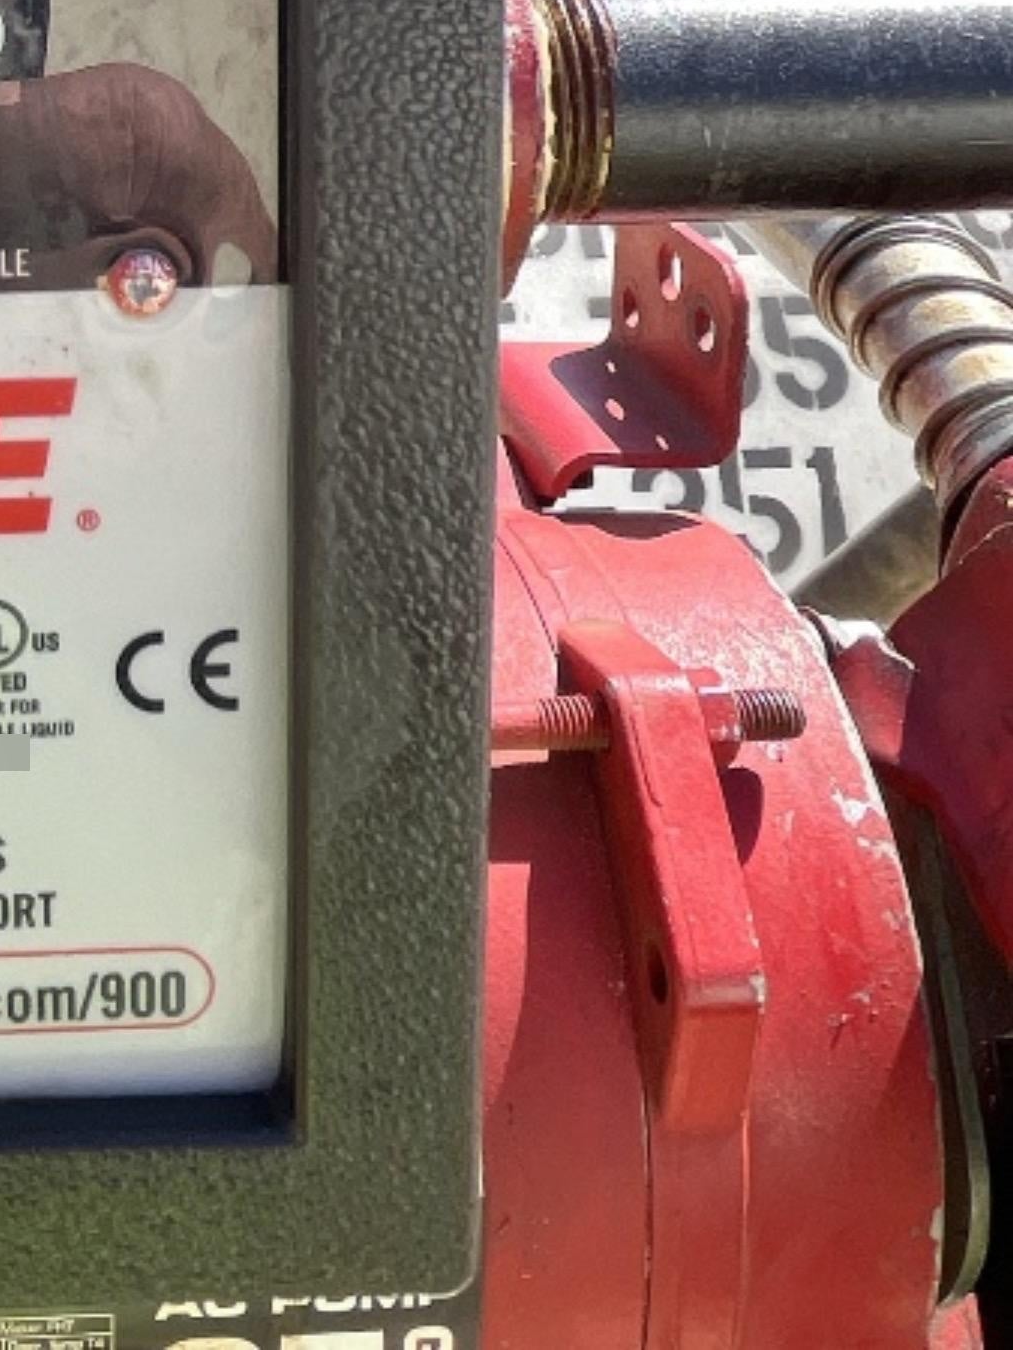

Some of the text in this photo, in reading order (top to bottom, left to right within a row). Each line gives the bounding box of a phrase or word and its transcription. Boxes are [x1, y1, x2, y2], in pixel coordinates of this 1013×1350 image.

[31, 631, 60, 653] US
[115, 628, 240, 714] CE
[10, 698, 41, 715] FOR
